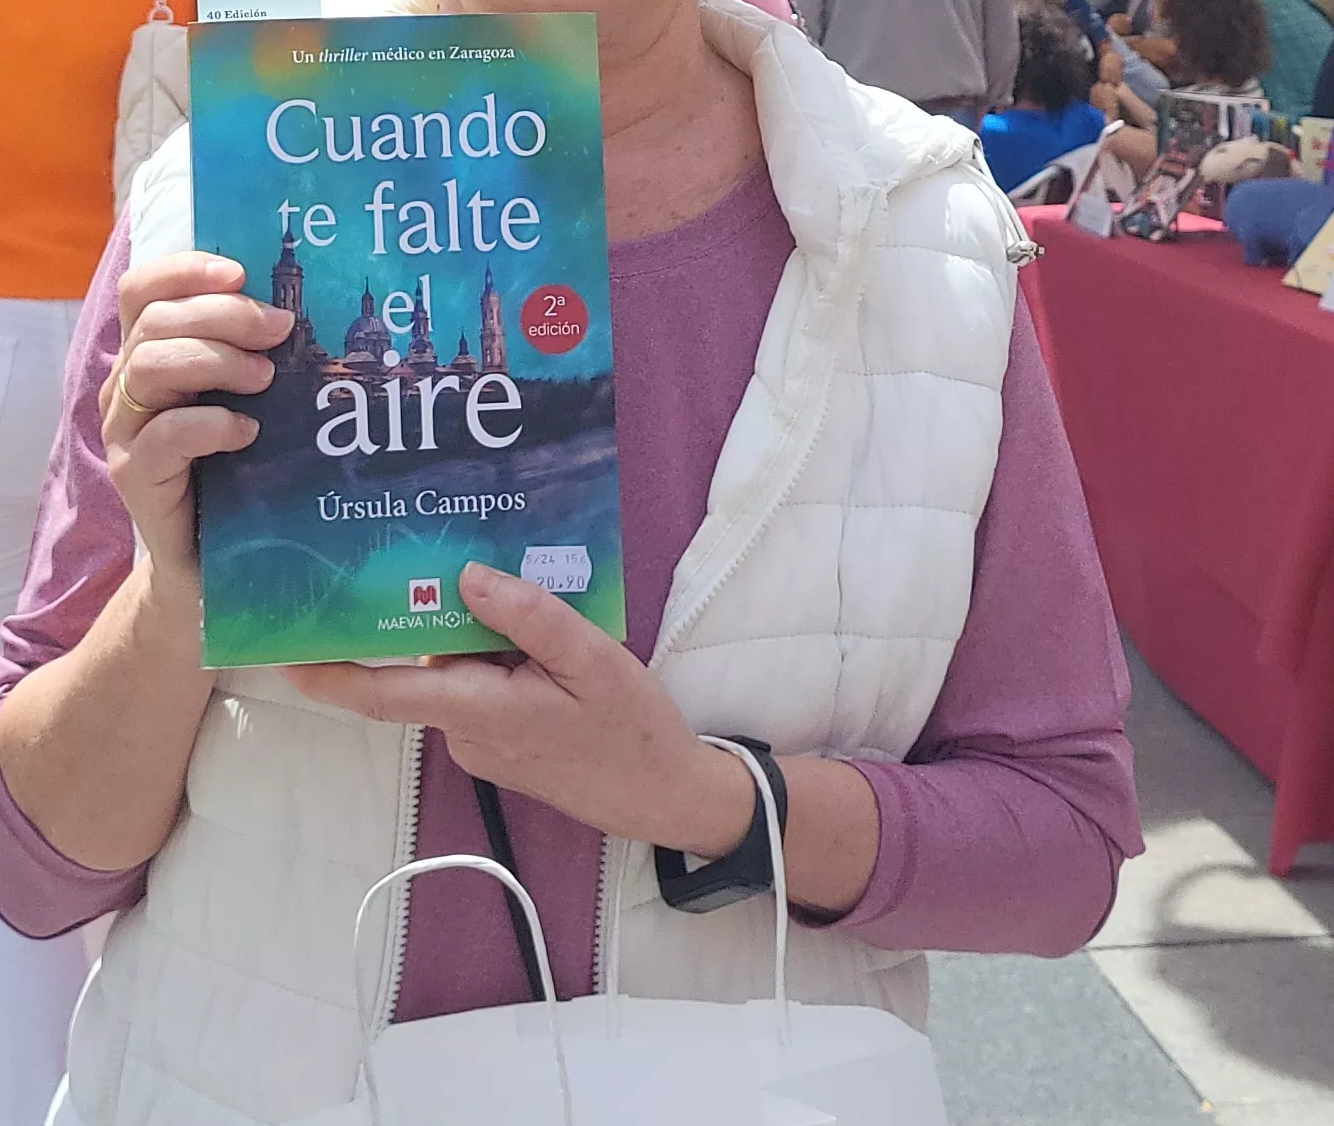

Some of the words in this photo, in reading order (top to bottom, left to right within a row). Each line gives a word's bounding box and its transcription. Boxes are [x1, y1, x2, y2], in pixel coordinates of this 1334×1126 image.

[206, 10, 222, 20] 40
[224, 8, 268, 19] Edición
[291, 50, 315, 64] Un
[318, 48, 369, 63] thriller
[371, 46, 425, 62] médico
[428, 48, 446, 60] en
[449, 46, 516, 64] Zaragoza
[266, 92, 547, 165] Cuando
[277, 198, 338, 248] te
[364, 178, 541, 255] falte
[382, 274, 434, 335] el
[528, 321, 580, 337] edición
[316, 349, 524, 457] aire
[317, 490, 409, 522] Úrsula
[416, 489, 527, 521] Campos
[377, 616, 424, 630] MAEVA
